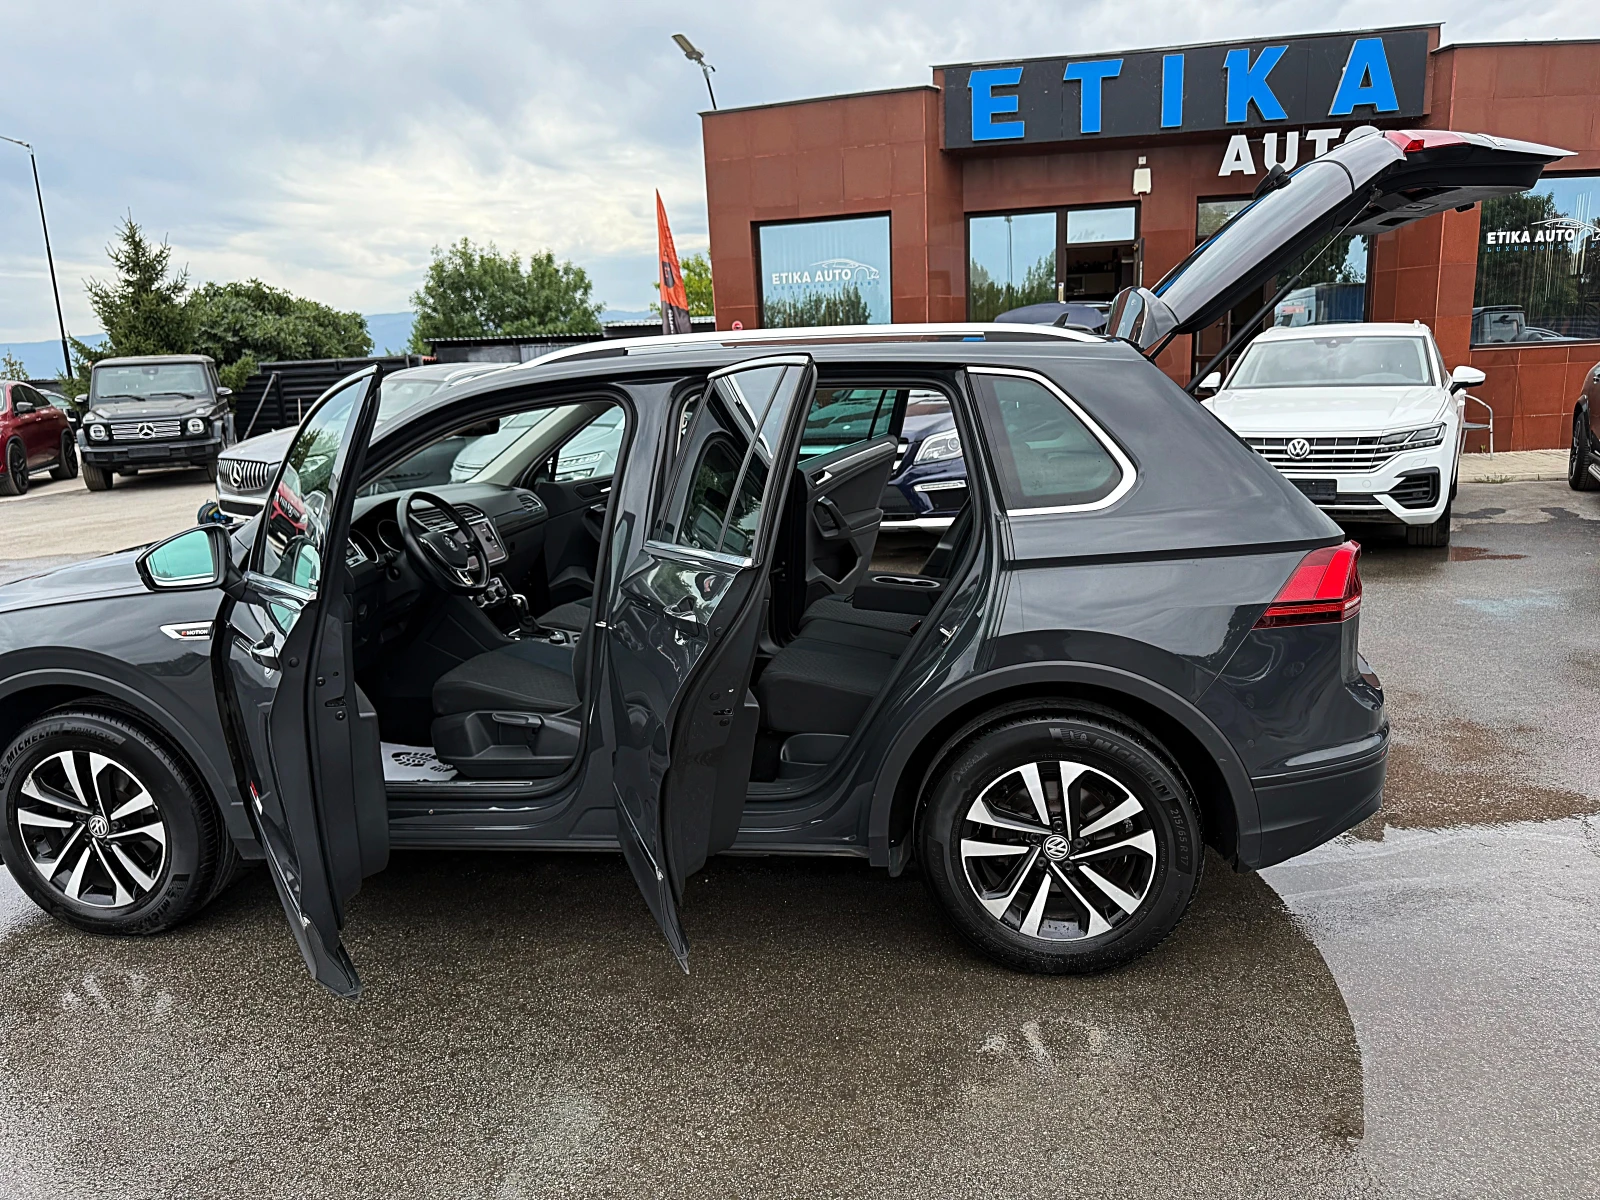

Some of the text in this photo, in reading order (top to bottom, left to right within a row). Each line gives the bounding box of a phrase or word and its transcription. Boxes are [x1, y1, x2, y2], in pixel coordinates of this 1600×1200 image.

[968, 37, 1399, 141] ETIKA
[1487, 229, 1576, 244] ETIKA AUTO
[771, 269, 852, 284] ETIKA AUTO
